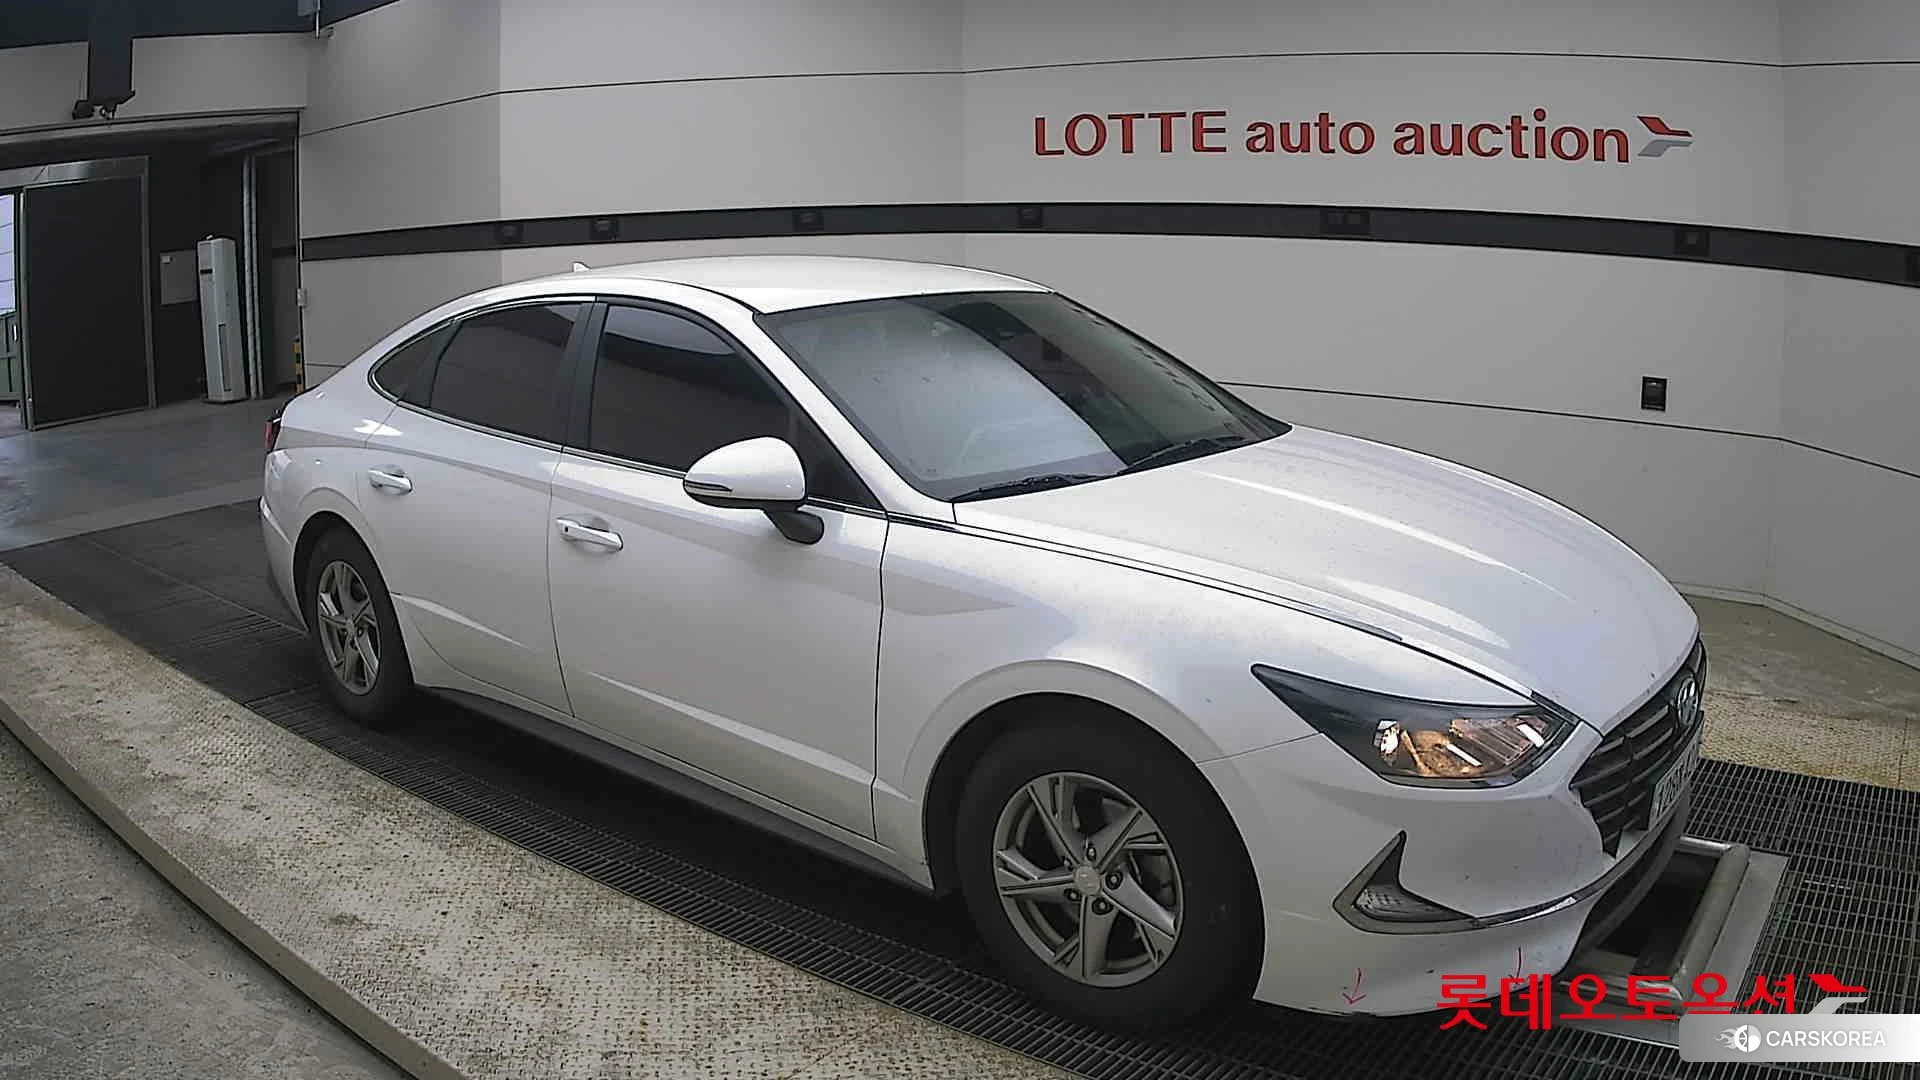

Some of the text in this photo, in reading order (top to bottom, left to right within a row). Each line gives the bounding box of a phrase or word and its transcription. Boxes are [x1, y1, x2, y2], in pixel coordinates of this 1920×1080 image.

[1034, 107, 1630, 163] LOTTE auto auction
